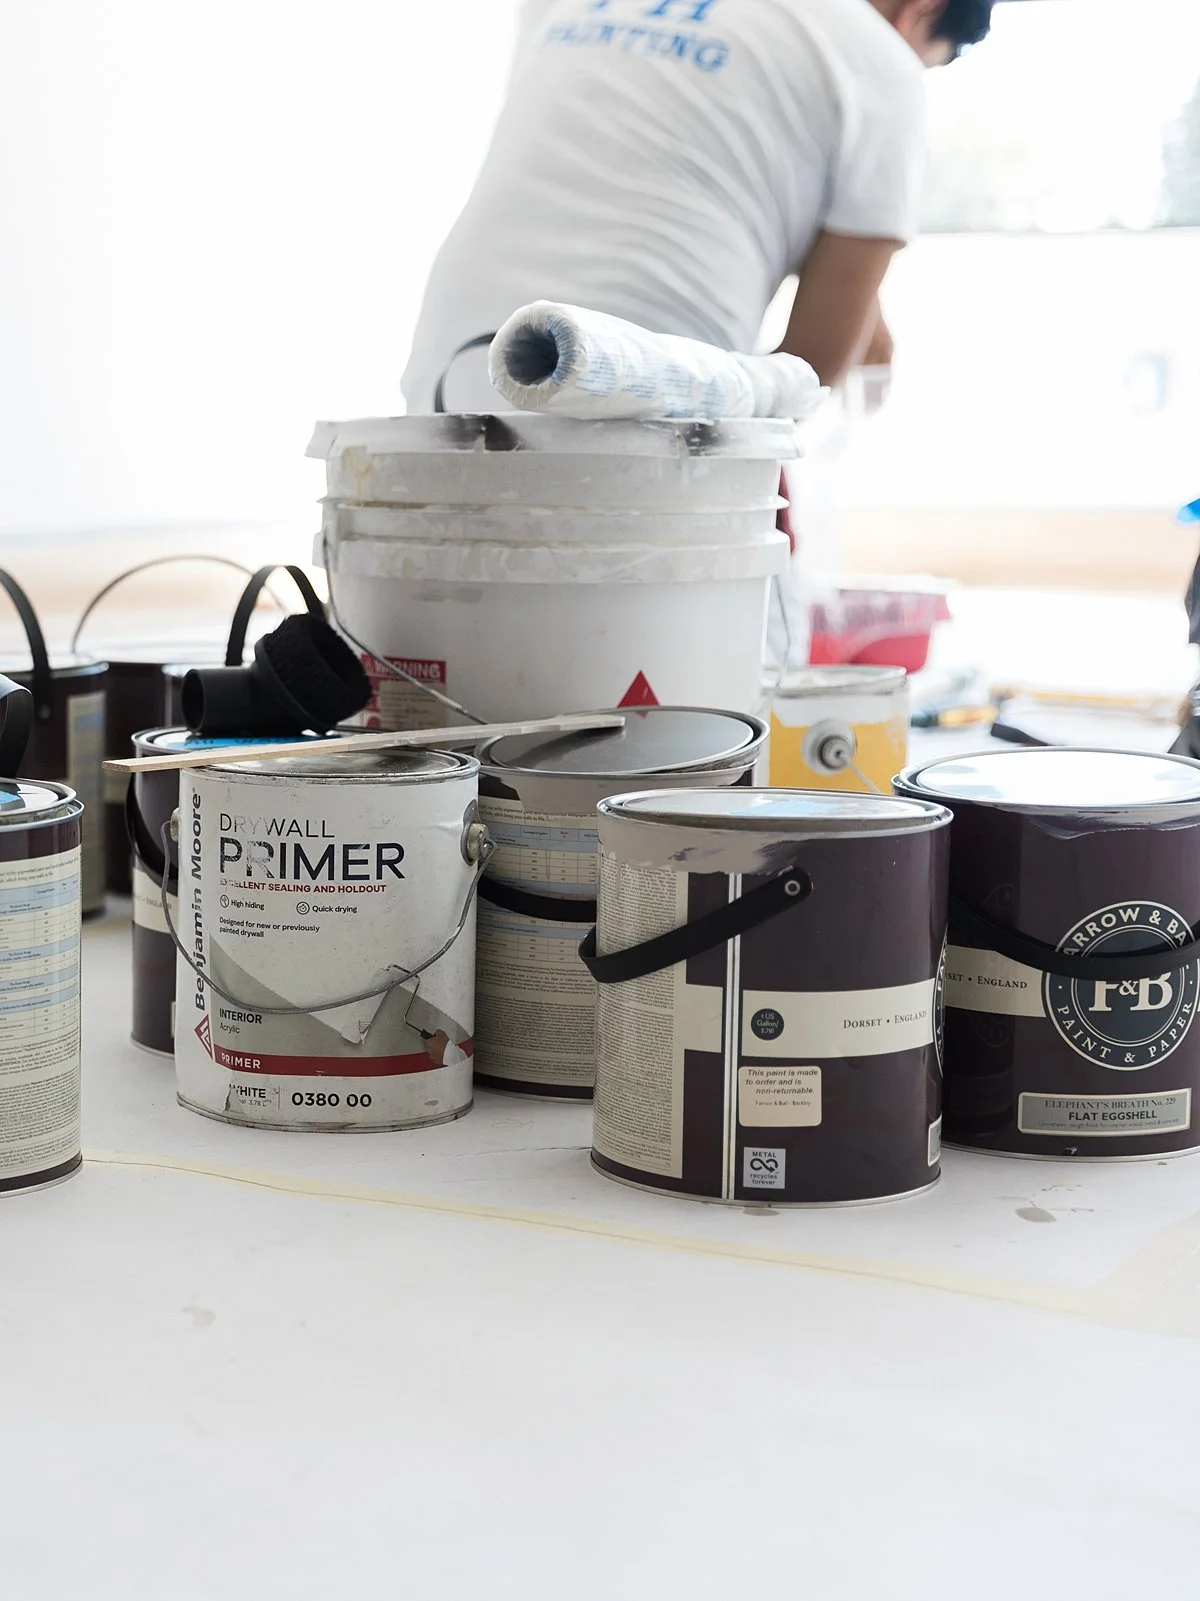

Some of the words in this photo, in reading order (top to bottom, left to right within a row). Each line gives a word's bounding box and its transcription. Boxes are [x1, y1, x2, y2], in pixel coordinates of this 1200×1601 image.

[374, 660, 441, 679] WRNING
[220, 813, 335, 838] DRYWALL
[219, 836, 406, 881] PRIMER
[268, 882, 311, 893] SEALING
[313, 883, 336, 894] AND
[338, 883, 387, 893] HOLDOUT
[231, 899, 244, 908] High
[245, 900, 265, 911] hiding
[312, 904, 333, 913] Quick
[337, 904, 358, 914] drying
[219, 916, 244, 928] Designed
[245, 920, 255, 928] for
[282, 923, 320, 933] previously
[219, 926, 239, 936] painted
[241, 929, 264, 938] drywall
[1063, 907, 1141, 955] ARROW
[1149, 909, 1162, 925] &
[191, 888, 206, 1011] Benjamin
[945, 972, 963, 981] SET
[977, 975, 1028, 989] ENGLAND
[219, 1007, 262, 1024] INTERIOR
[843, 1019, 882, 1029] DORSET
[894, 1010, 927, 1024] ENGLAND
[219, 1022, 240, 1034] Acrylic
[1057, 1004, 1112, 1059] PAINT
[1124, 1053, 1135, 1063] &
[1149, 1002, 1193, 1057] PAPER
[221, 1052, 261, 1070] PRIMER
[748, 1069, 764, 1077] This
[766, 1070, 786, 1078] paint
[291, 1092, 340, 1106] 0380
[346, 1093, 372, 1107] 00
[1045, 1100, 1109, 1109] ELEPHANT'S
[1112, 1099, 1149, 1109] BREATH
[1069, 1111, 1098, 1121] FLAT
[1101, 1110, 1157, 1121] EGGSHELL
